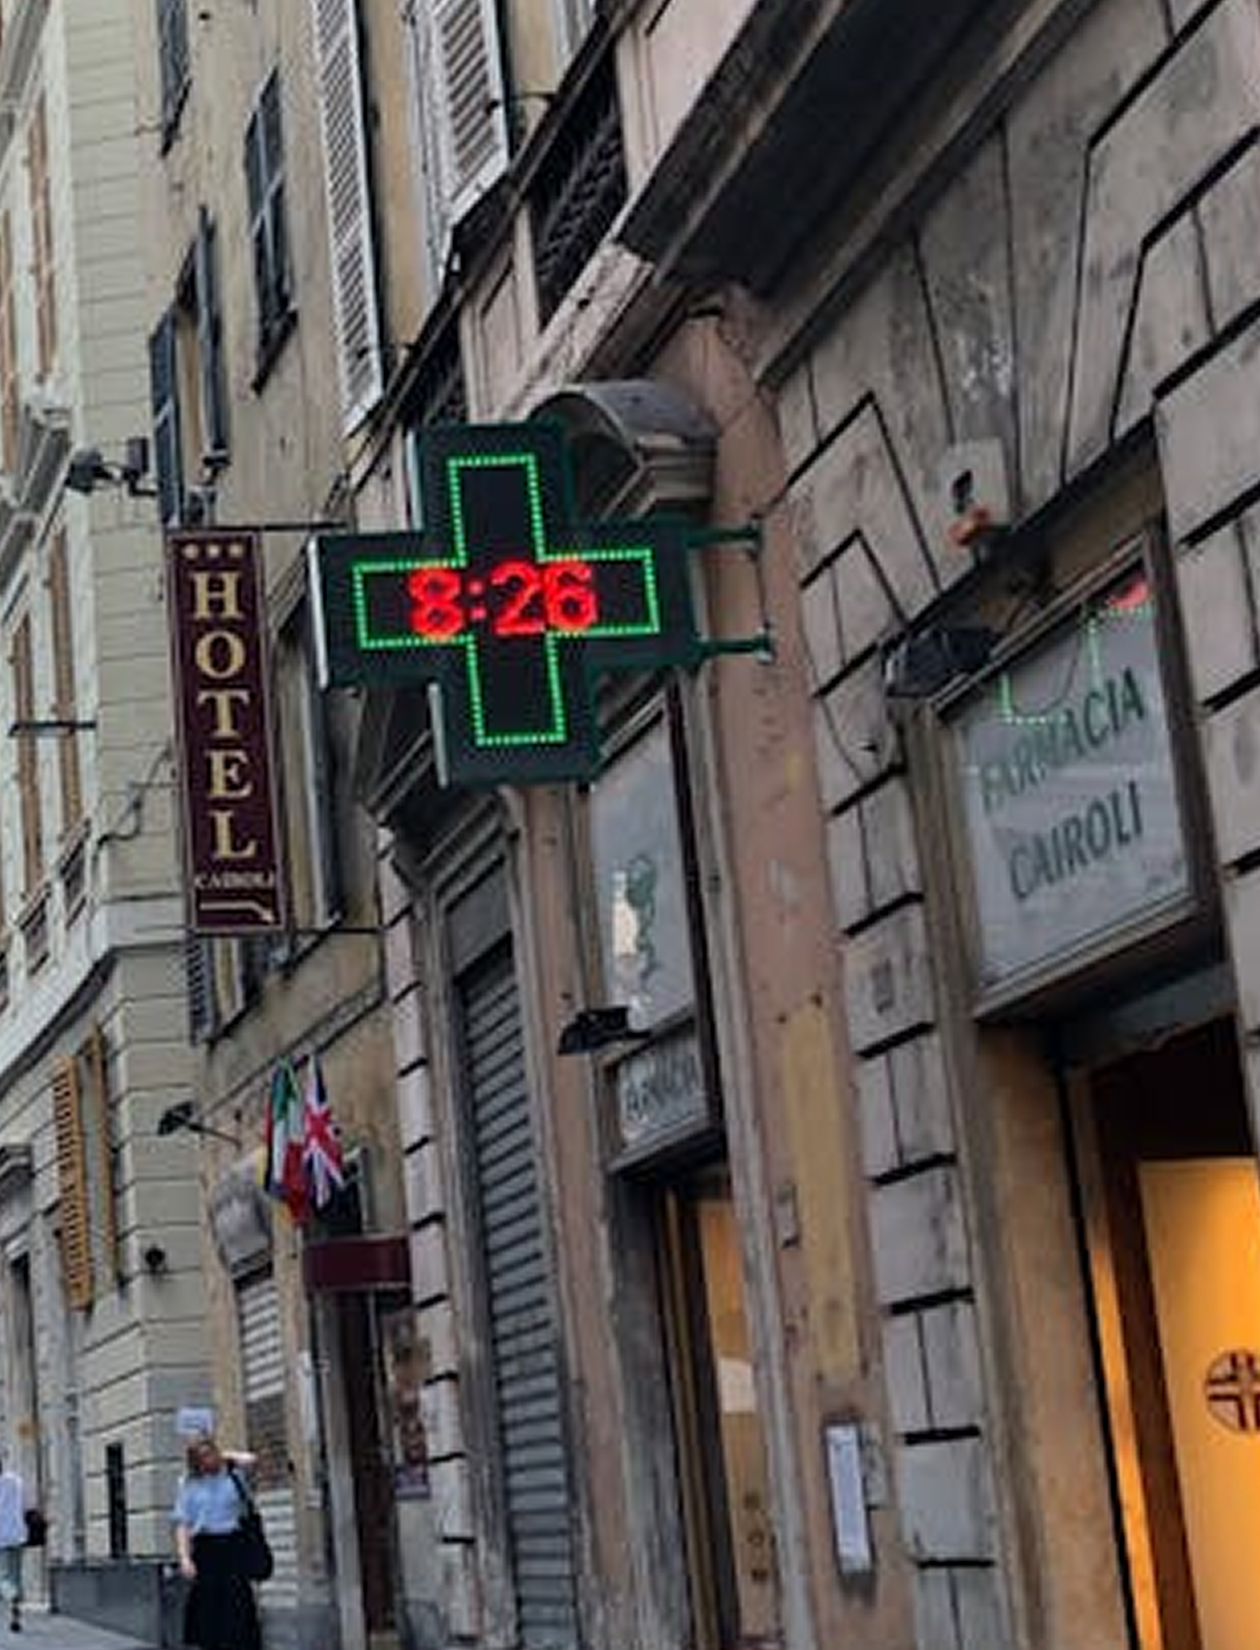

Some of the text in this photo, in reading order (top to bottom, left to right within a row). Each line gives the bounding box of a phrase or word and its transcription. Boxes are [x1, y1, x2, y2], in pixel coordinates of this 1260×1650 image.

[408, 560, 598, 639] 8:26
[191, 571, 258, 860] HOTEL
[980, 666, 1146, 815] FARMACIA
[1009, 780, 1144, 900] CAIROLI
